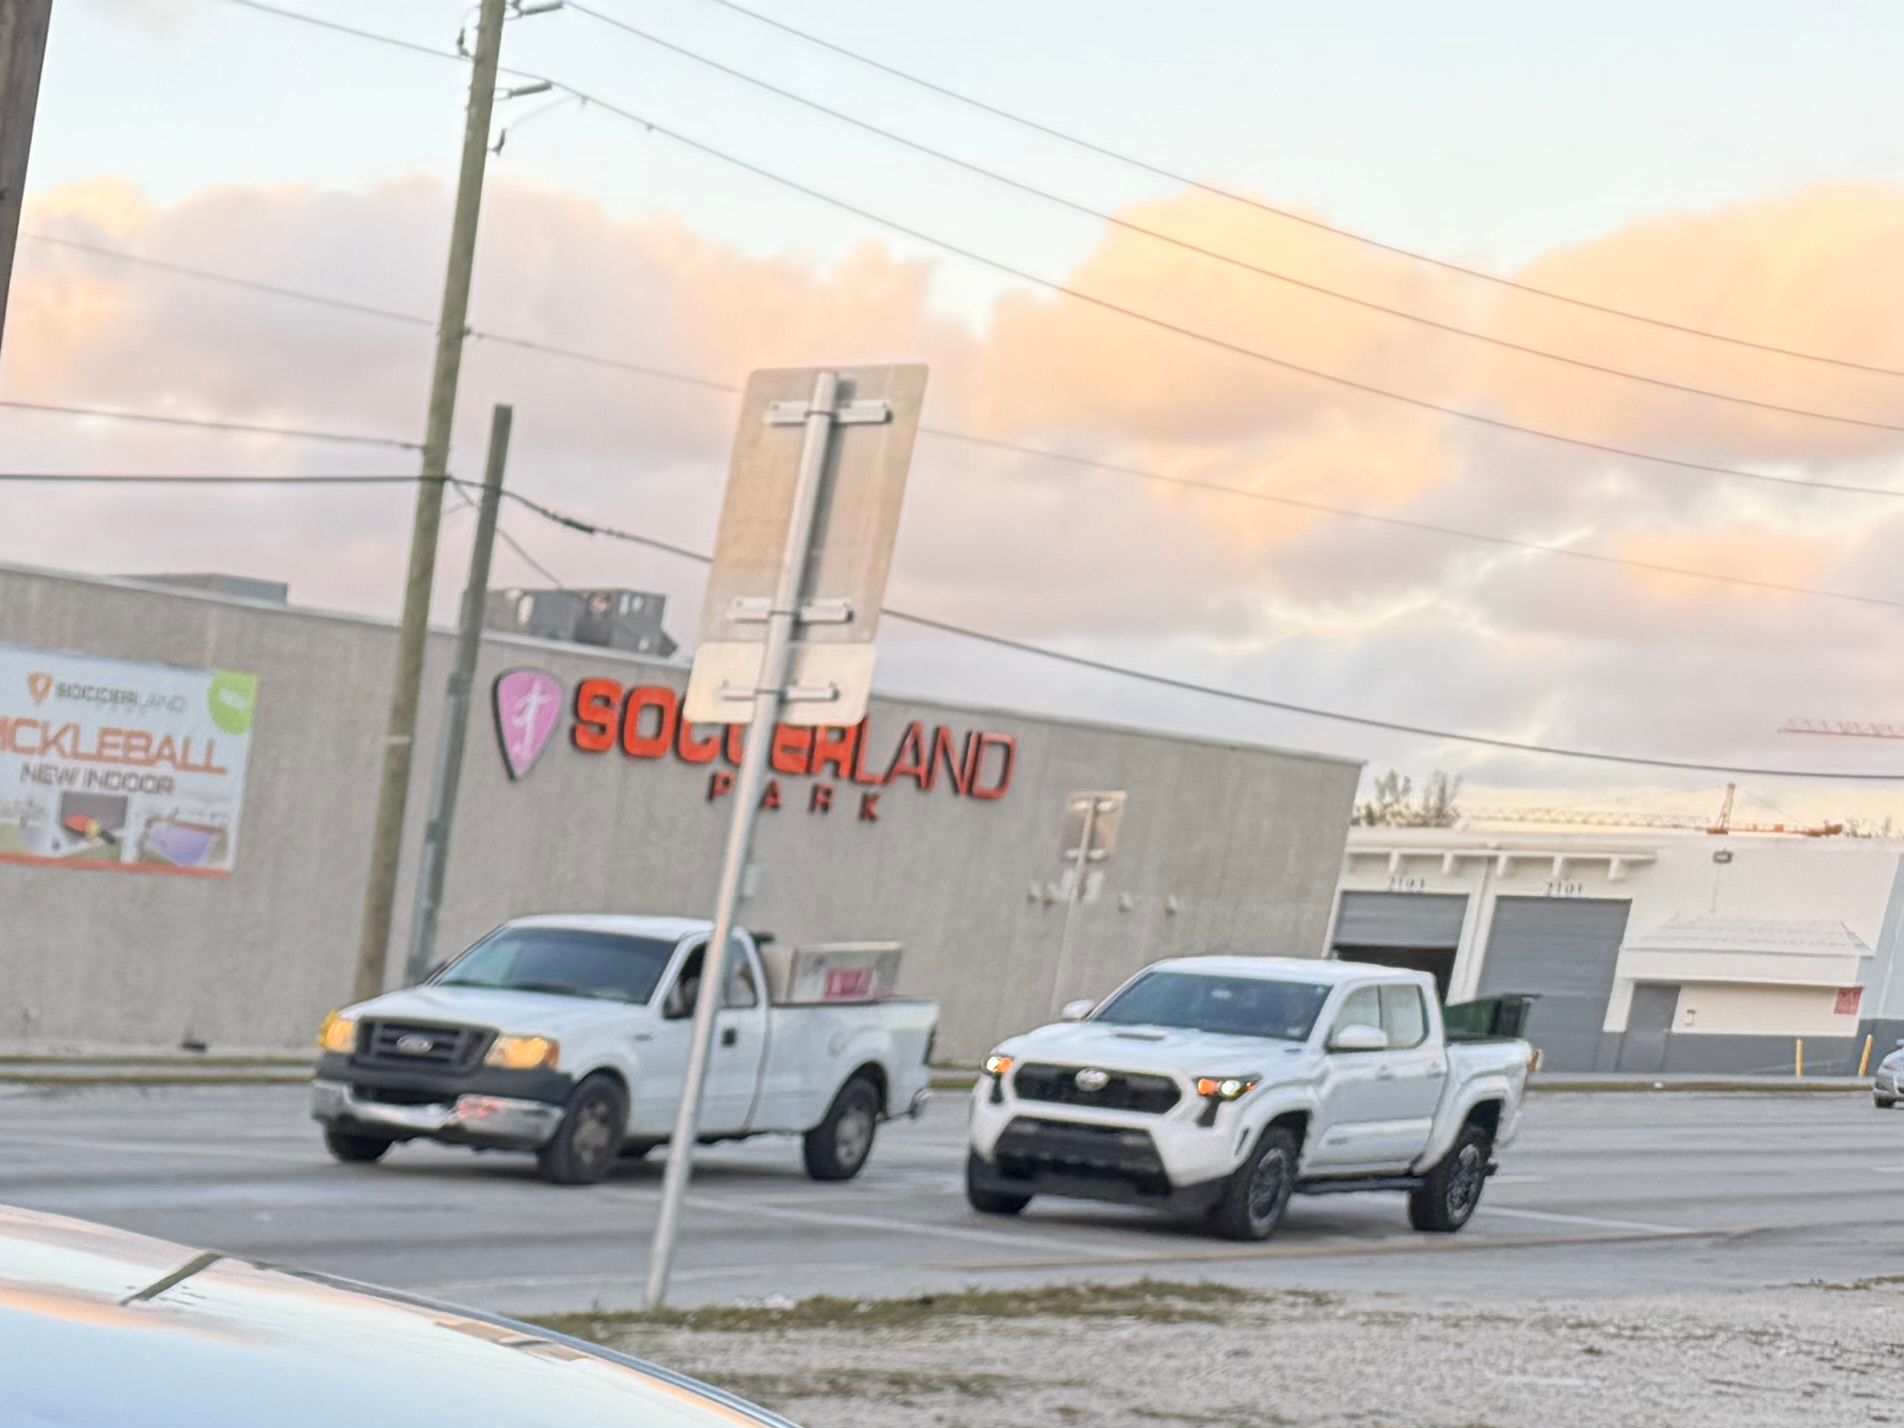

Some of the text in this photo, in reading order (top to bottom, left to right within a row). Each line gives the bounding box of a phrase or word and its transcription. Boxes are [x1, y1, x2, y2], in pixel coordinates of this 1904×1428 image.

[19, 761, 176, 796] NEW INDOOR
[706, 770, 882, 823] PARK
